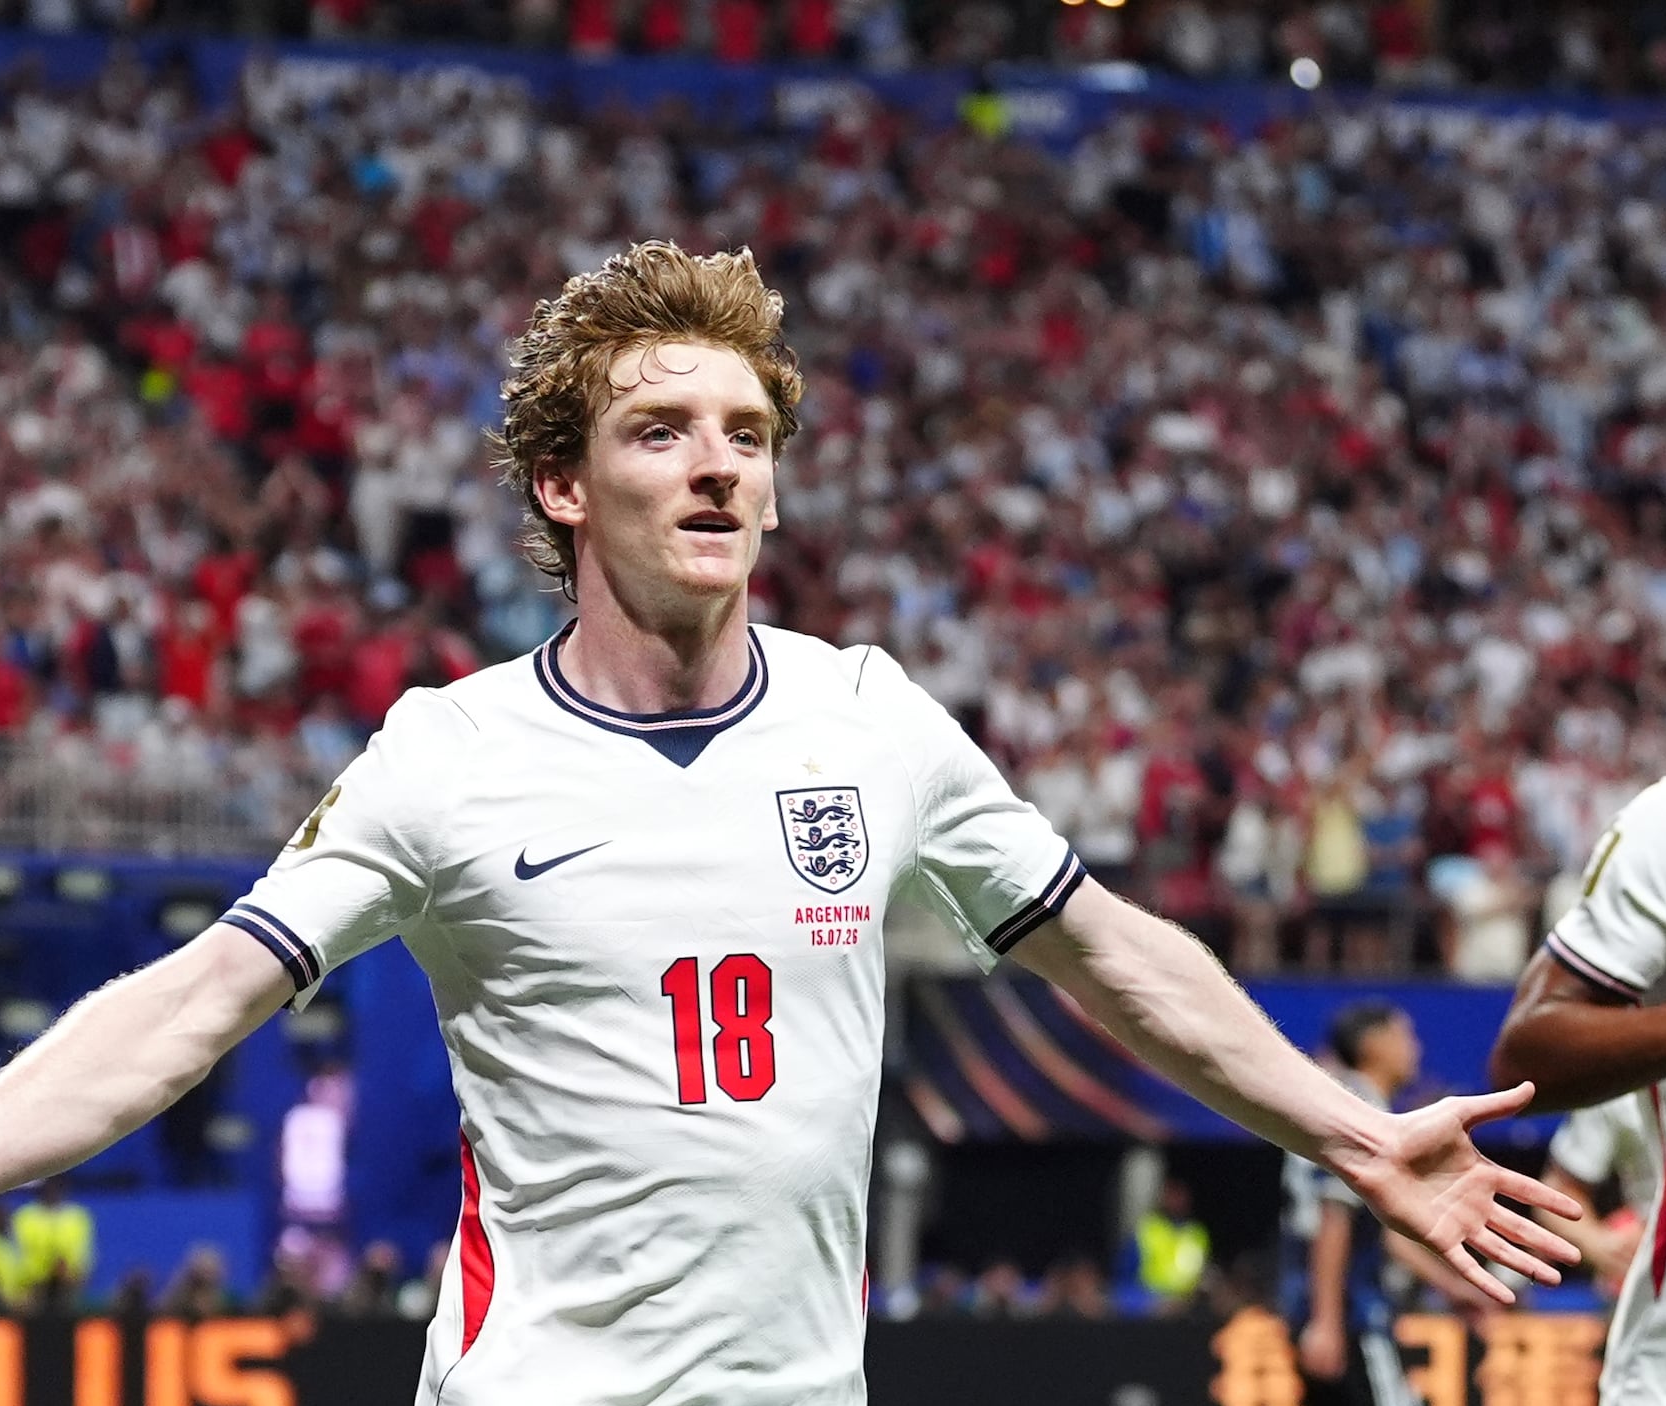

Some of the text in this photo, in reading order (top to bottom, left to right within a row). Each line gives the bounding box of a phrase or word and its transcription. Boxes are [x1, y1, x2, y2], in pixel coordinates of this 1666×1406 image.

[794, 904, 871, 925] ARGENTINA
[810, 928, 859, 946] 15.07.26
[660, 952, 776, 1106] 18
